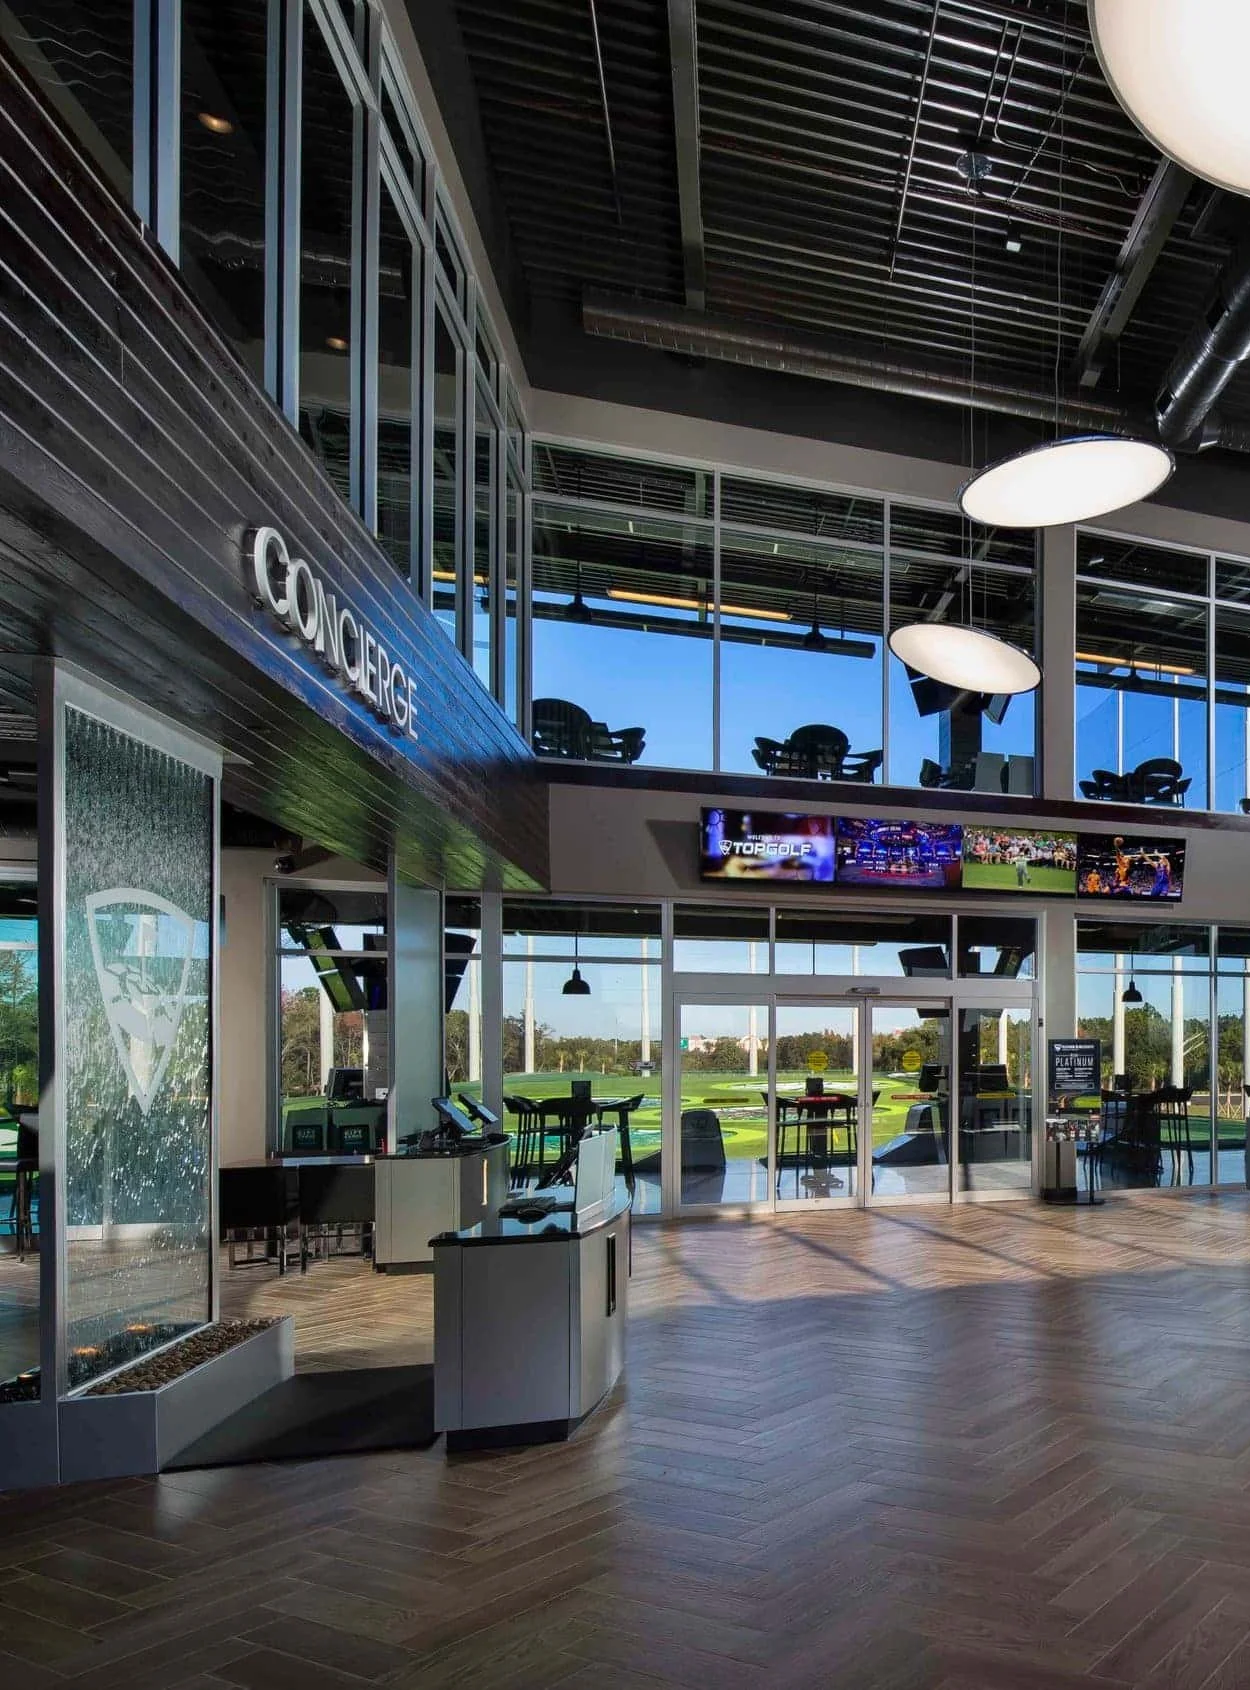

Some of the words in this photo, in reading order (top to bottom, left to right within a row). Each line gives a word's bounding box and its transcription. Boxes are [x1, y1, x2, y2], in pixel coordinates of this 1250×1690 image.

[254, 526, 418, 740] CONCIERGE
[733, 841, 812, 857] TOPGOLF
[1055, 1057, 1094, 1067] PLATINUM
